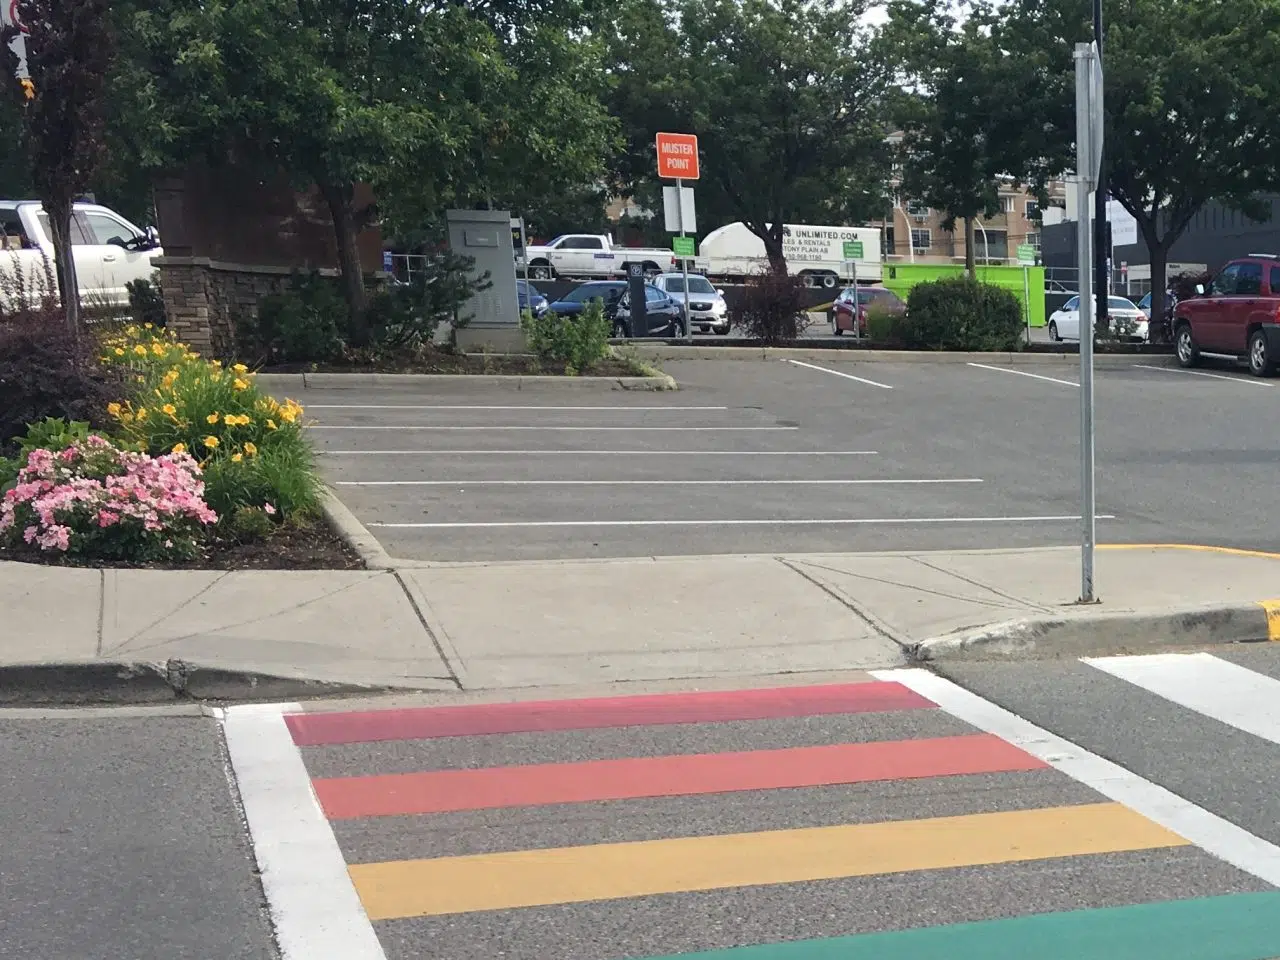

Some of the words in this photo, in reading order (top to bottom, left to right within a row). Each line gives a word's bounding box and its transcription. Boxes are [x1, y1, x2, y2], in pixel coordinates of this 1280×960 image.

[662, 142, 693, 155] MUSTER
[667, 158, 689, 169] POINT
[796, 231, 857, 240] UNLIMITED.COM
[804, 240, 831, 248] RENTALS
